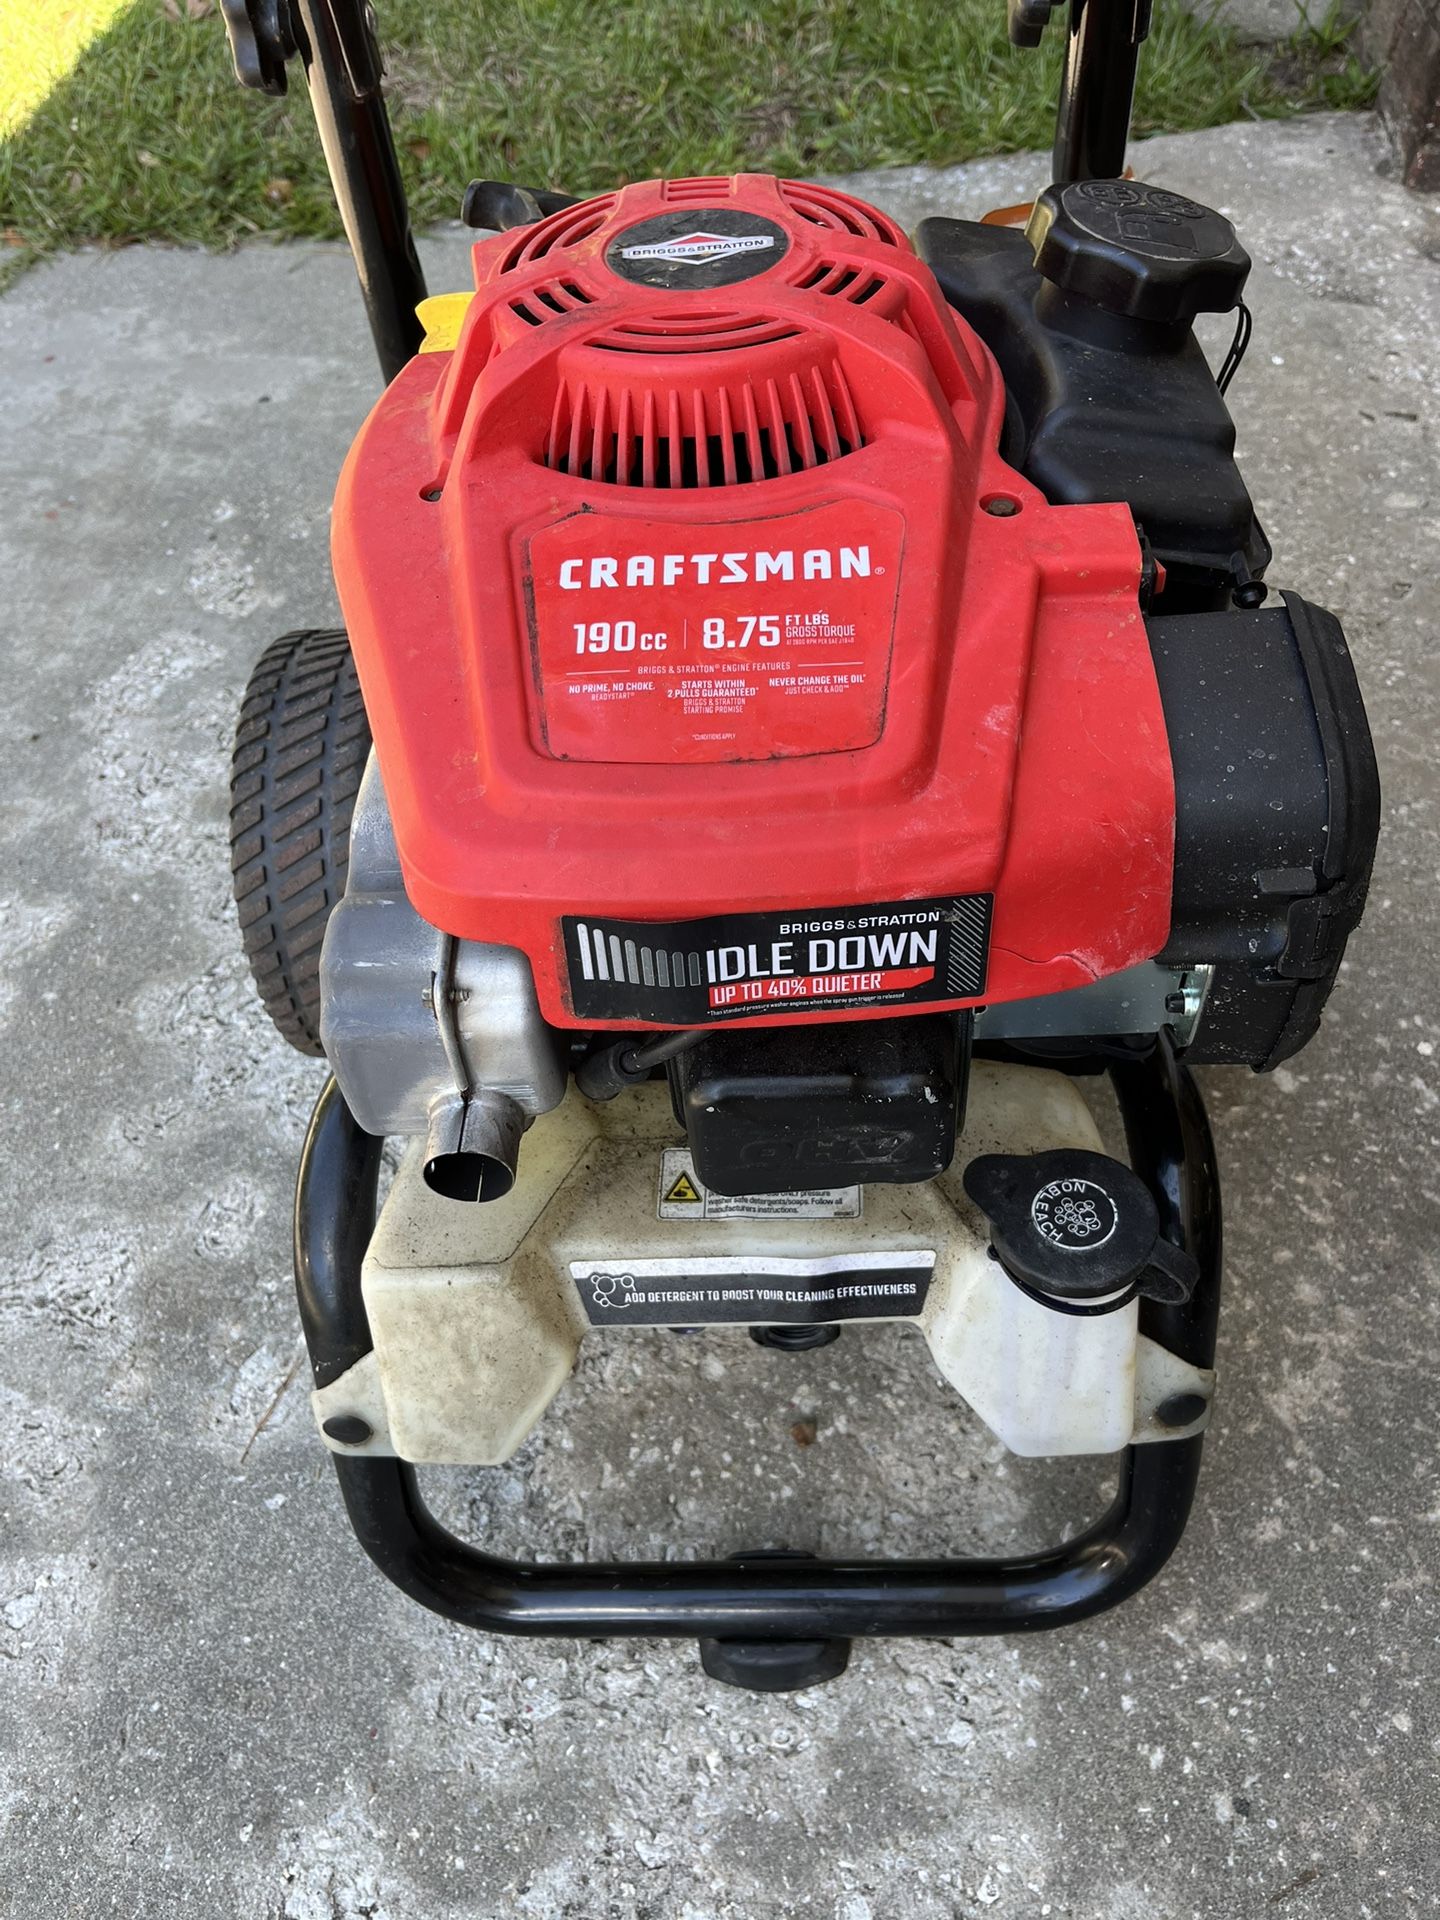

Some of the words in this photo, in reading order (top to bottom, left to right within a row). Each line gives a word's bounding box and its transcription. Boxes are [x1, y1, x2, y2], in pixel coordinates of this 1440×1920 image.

[785, 614, 801, 626] FT
[805, 613, 830, 626] LBS
[703, 615, 780, 649] 8.75
[785, 626, 818, 638] GROSS
[818, 624, 856, 638] TORQUE
[638, 665, 667, 674] BRIGGS
[668, 665, 675, 674] &
[722, 663, 751, 673] ENGINE
[752, 661, 791, 671] FEATURES
[569, 685, 581, 694] NO
[612, 682, 625, 692] NO
[626, 681, 656, 691] CHOKE.
[681, 680, 712, 689] STARTS
[714, 679, 745, 689] WITHIN
[769, 677, 796, 687] NEVER
[798, 676, 831, 686] CHANGE
[833, 675, 849, 684] THE
[667, 690, 673, 699] 2
[675, 689, 700, 698] PULLS
[785, 687, 801, 695] JUST
[802, 686, 823, 695] CHECK
[683, 698, 708, 707] BRIGGS
[715, 697, 746, 706] STRATTON
[683, 705, 714, 715] STARTING
[715, 705, 744, 714] PROMISE
[706, 941, 794, 983] IDLE
[809, 929, 938, 973] DOWN
[713, 986, 736, 1005] UP
[741, 983, 763, 1000] TO
[768, 978, 807, 997] 40%
[1061, 1181, 1086, 1193] NO
[811, 1197, 833, 1205] Follow
[834, 1197, 843, 1205] all
[1035, 1185, 1063, 1241] BLEACH
[624, 1292, 644, 1303] ADD
[647, 1290, 705, 1302] DETERGENT
[707, 1290, 721, 1300] TO
[722, 1289, 755, 1301] BOOST
[756, 1289, 784, 1301] YOUR
[785, 1288, 835, 1302] CLEANING
[836, 1283, 917, 1298] EFFECTIVENESS
